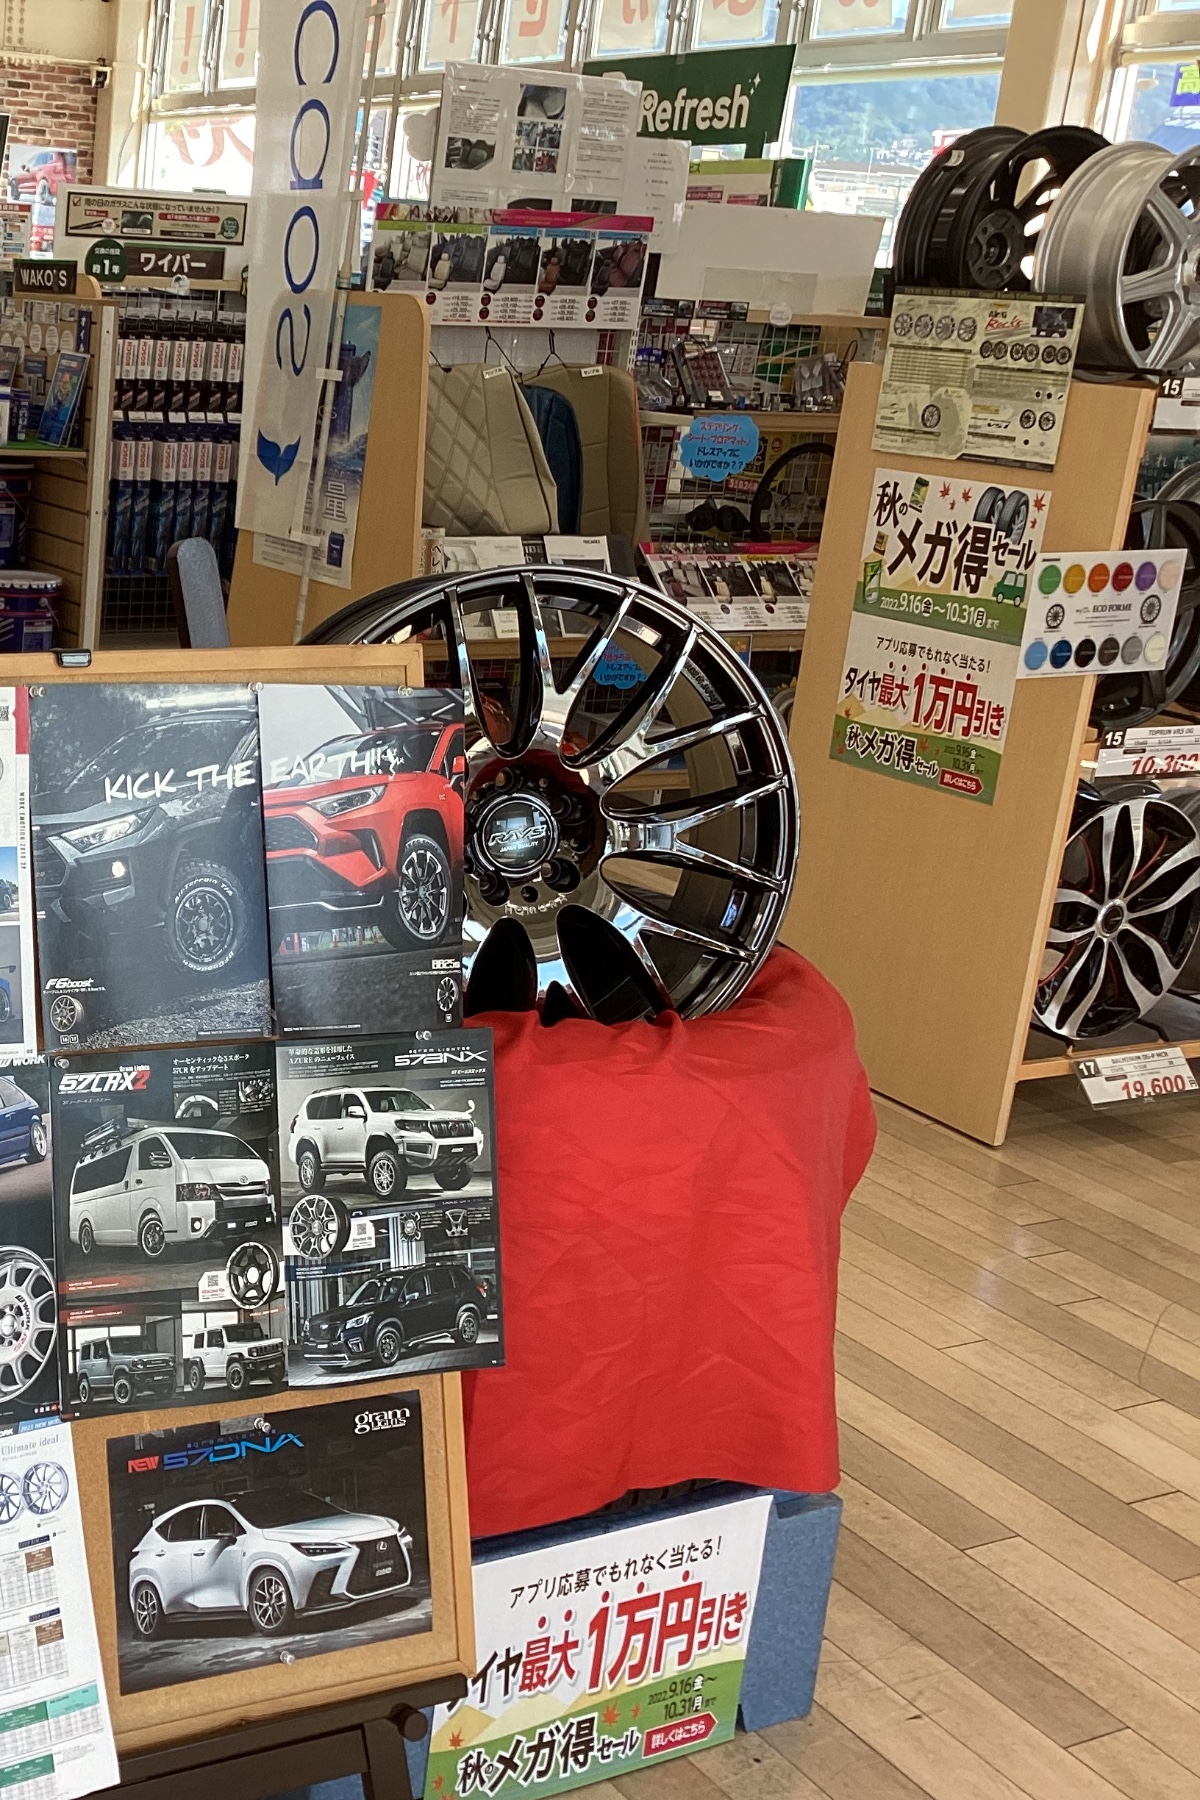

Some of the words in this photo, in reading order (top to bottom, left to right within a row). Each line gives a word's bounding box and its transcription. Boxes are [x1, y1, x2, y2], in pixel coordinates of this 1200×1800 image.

[640, 83, 750, 132] Refresh
[140, 252, 206, 273] ワイパー
[20, 269, 67, 287] WAKO'S
[1162, 379, 1180, 395] 15
[873, 480, 908, 528] 秋の
[887, 517, 1036, 594] メガ得セール
[1092, 604, 1107, 613] ECO
[1108, 603, 1132, 612] FORME
[876, 636, 991, 673] アプリ応募でもれなく当たる！
[845, 667, 1005, 738] タイヤ最大1万円引き
[1105, 732, 1123, 746] 15
[105, 767, 177, 803] KICK
[186, 760, 256, 792] THE
[488, 824, 547, 846] RAYS
[12, 1054, 46, 1067] WORK
[288, 1056, 313, 1065] AZURE
[314, 1054, 355, 1063] のニューフェイス
[1079, 1061, 1096, 1076] 17
[354, 1406, 411, 1435] gram
[1, 1441, 37, 1455] Ultimate
[40, 1434, 59, 1447] ideal
[509, 1536, 722, 1609] アプリ応募でもれなく当たる！
[651, 1720, 707, 1750] 詳しくはこちら
[459, 1716, 641, 1796] 秋のメガ得セール
